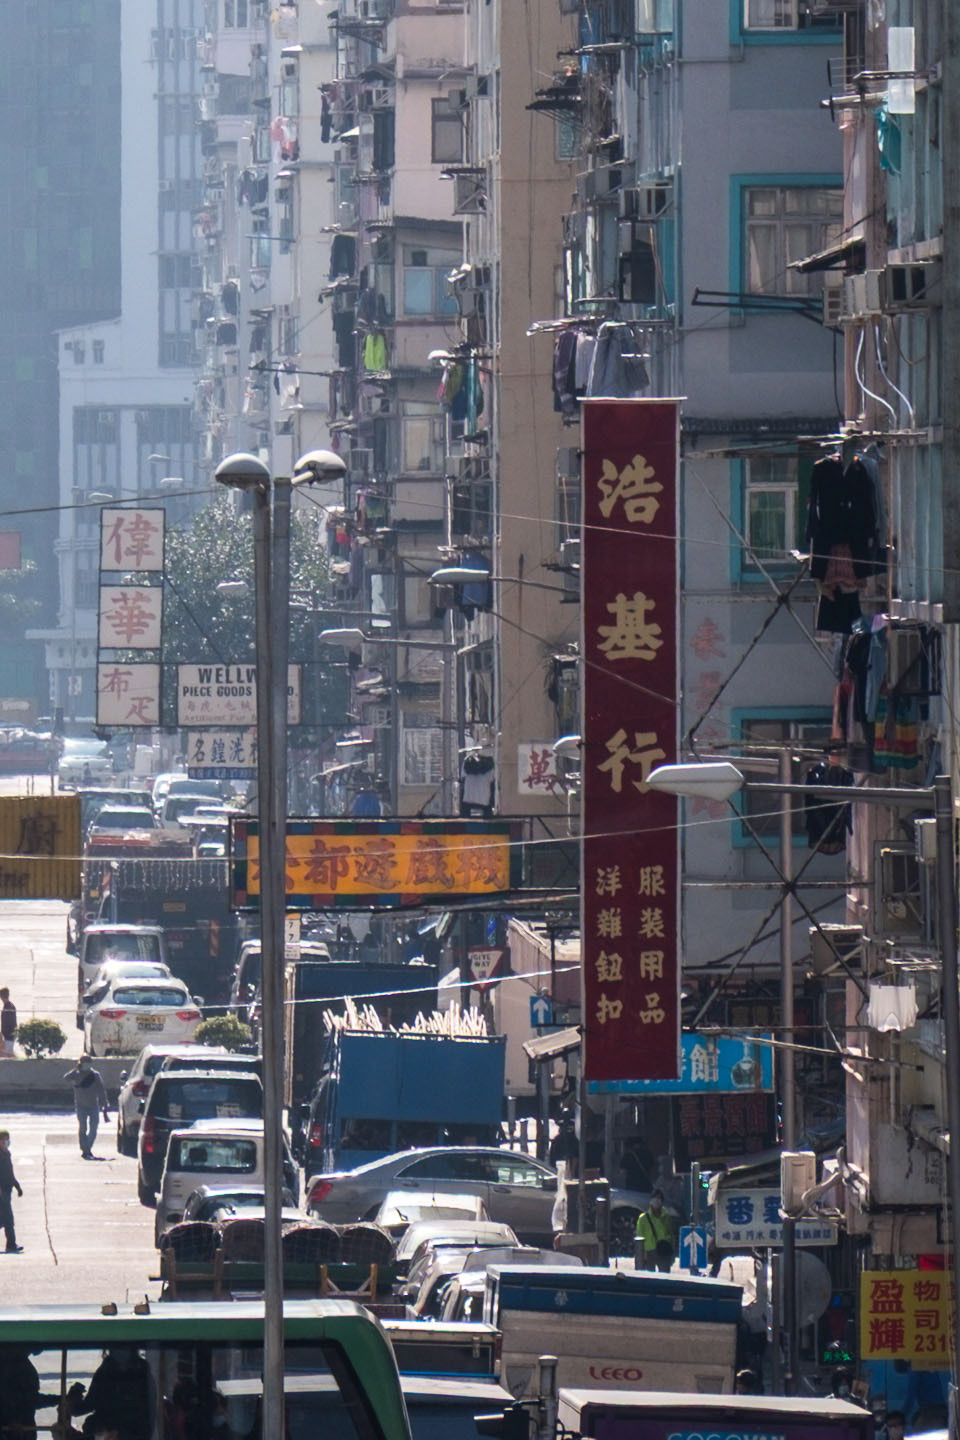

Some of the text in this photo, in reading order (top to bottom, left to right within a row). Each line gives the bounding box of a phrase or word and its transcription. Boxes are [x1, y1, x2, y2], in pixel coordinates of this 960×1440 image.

[597, 453, 666, 793] 浩基行
[182, 686, 212, 697] PIECE
[216, 686, 252, 697] GOODS
[594, 864, 624, 1025] 洋雜鈕扣
[868, 1278, 906, 1353] 盈輝
